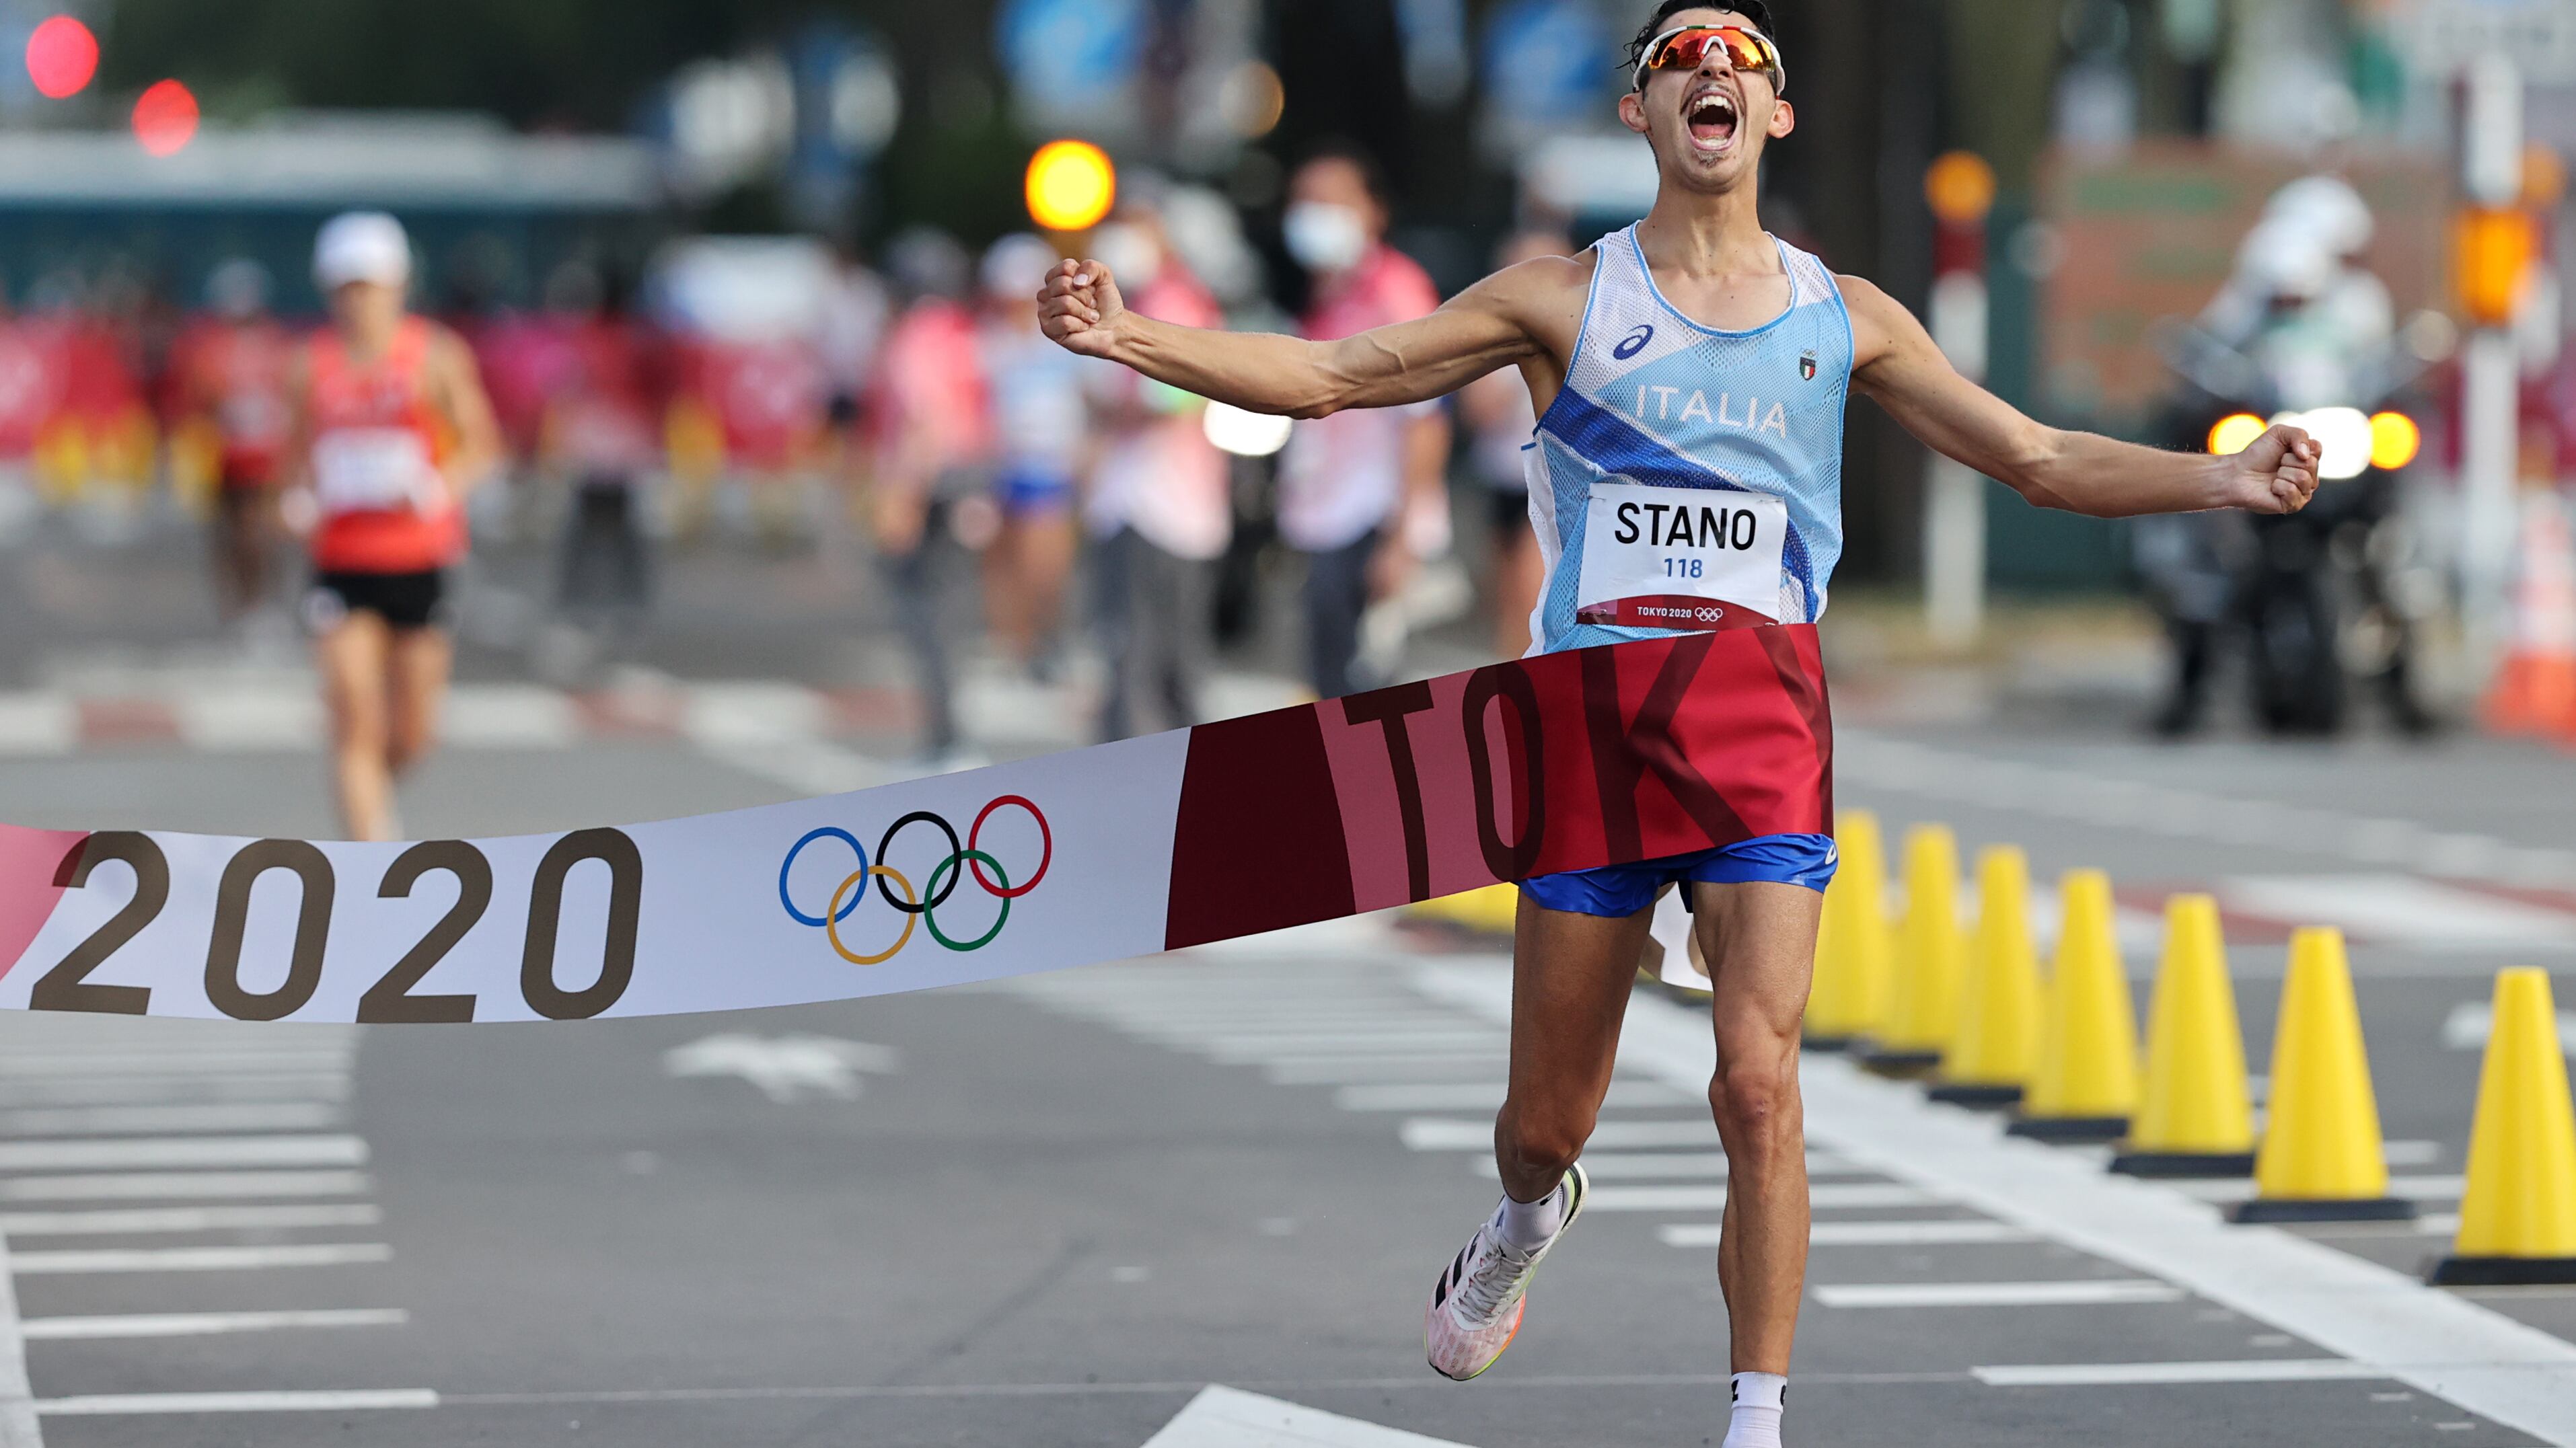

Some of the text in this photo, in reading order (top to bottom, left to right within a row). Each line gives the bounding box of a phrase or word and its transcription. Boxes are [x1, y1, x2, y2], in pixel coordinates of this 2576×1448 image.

[1635, 385, 1786, 439] ITALIA
[1615, 502, 1757, 550] STANO
[1664, 558, 1703, 578] 118
[1637, 607, 1692, 618] TOKYO 2020
[28, 827, 643, 1024] 2020
